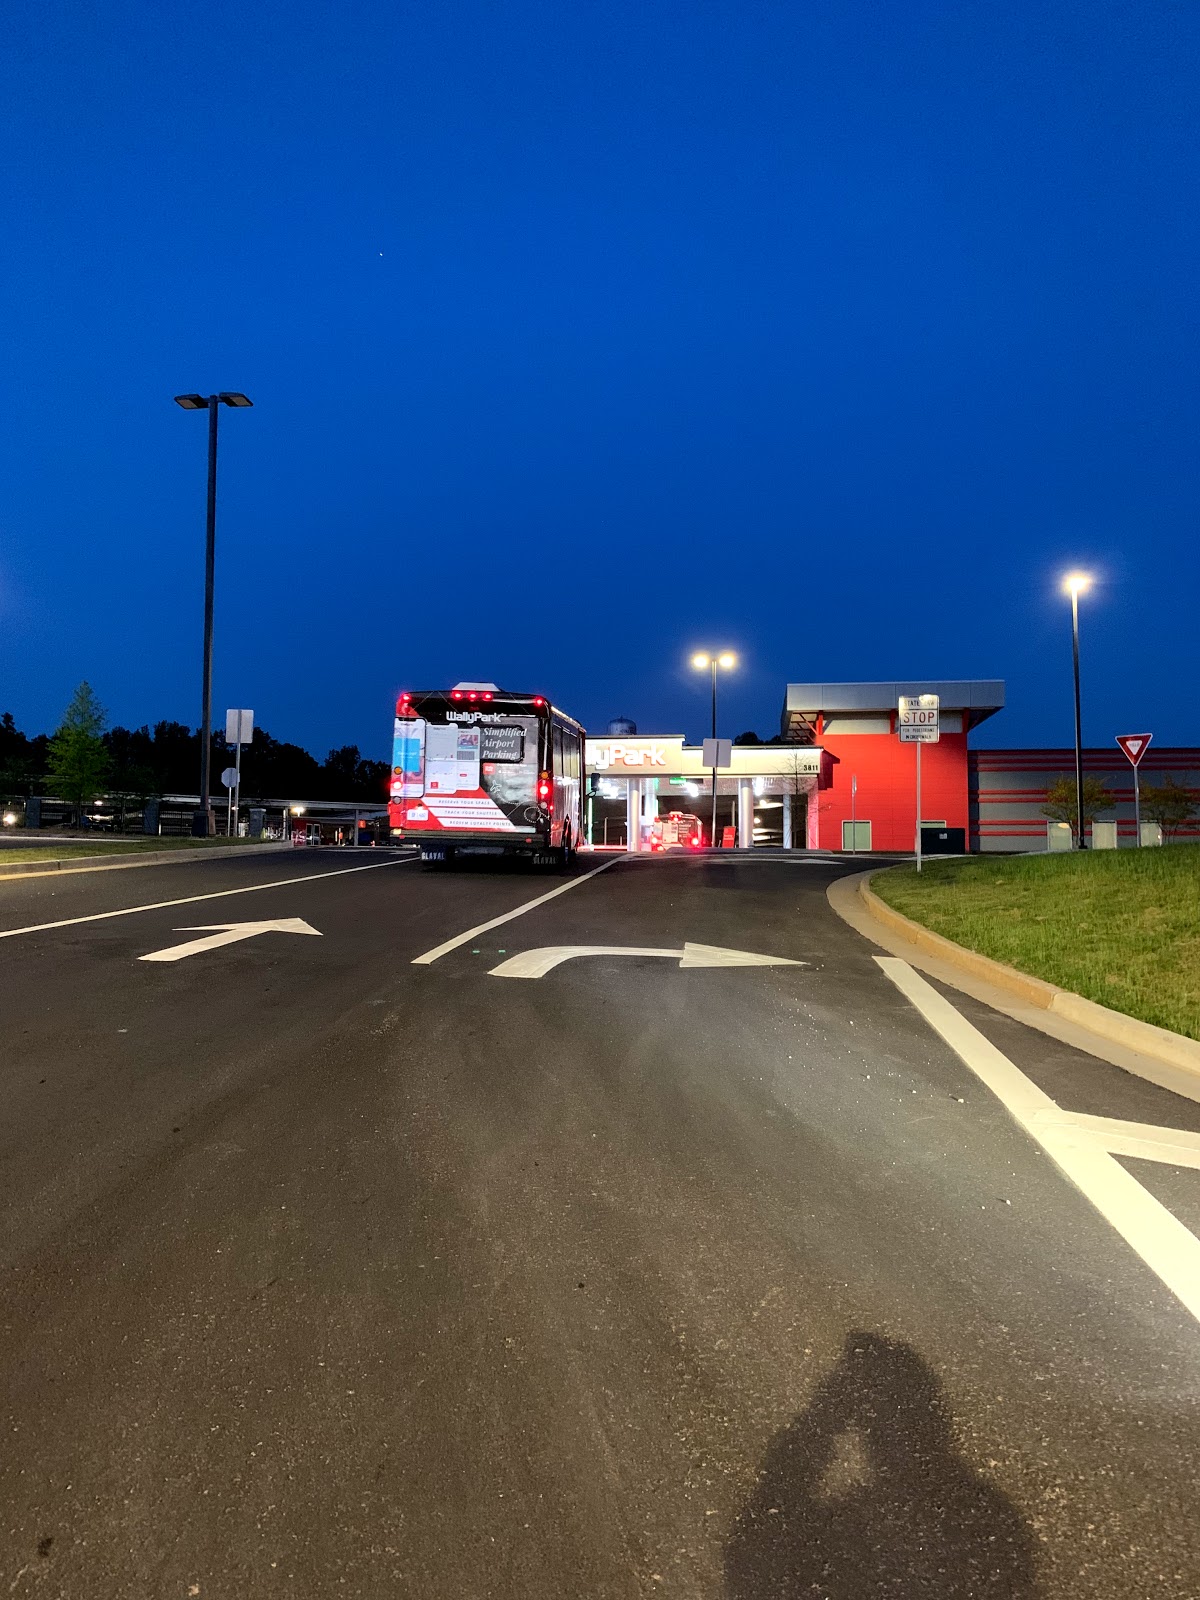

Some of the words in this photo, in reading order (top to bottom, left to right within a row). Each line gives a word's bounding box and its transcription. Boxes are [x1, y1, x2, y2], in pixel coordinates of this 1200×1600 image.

[446, 711, 501, 723] WallyPark
[903, 711, 935, 723] STOP
[482, 727, 527, 738] Simplified
[482, 739, 515, 748] Airport
[482, 750, 518, 760] Parking
[585, 744, 666, 770] llyPark
[421, 852, 445, 860] GLAVAL
